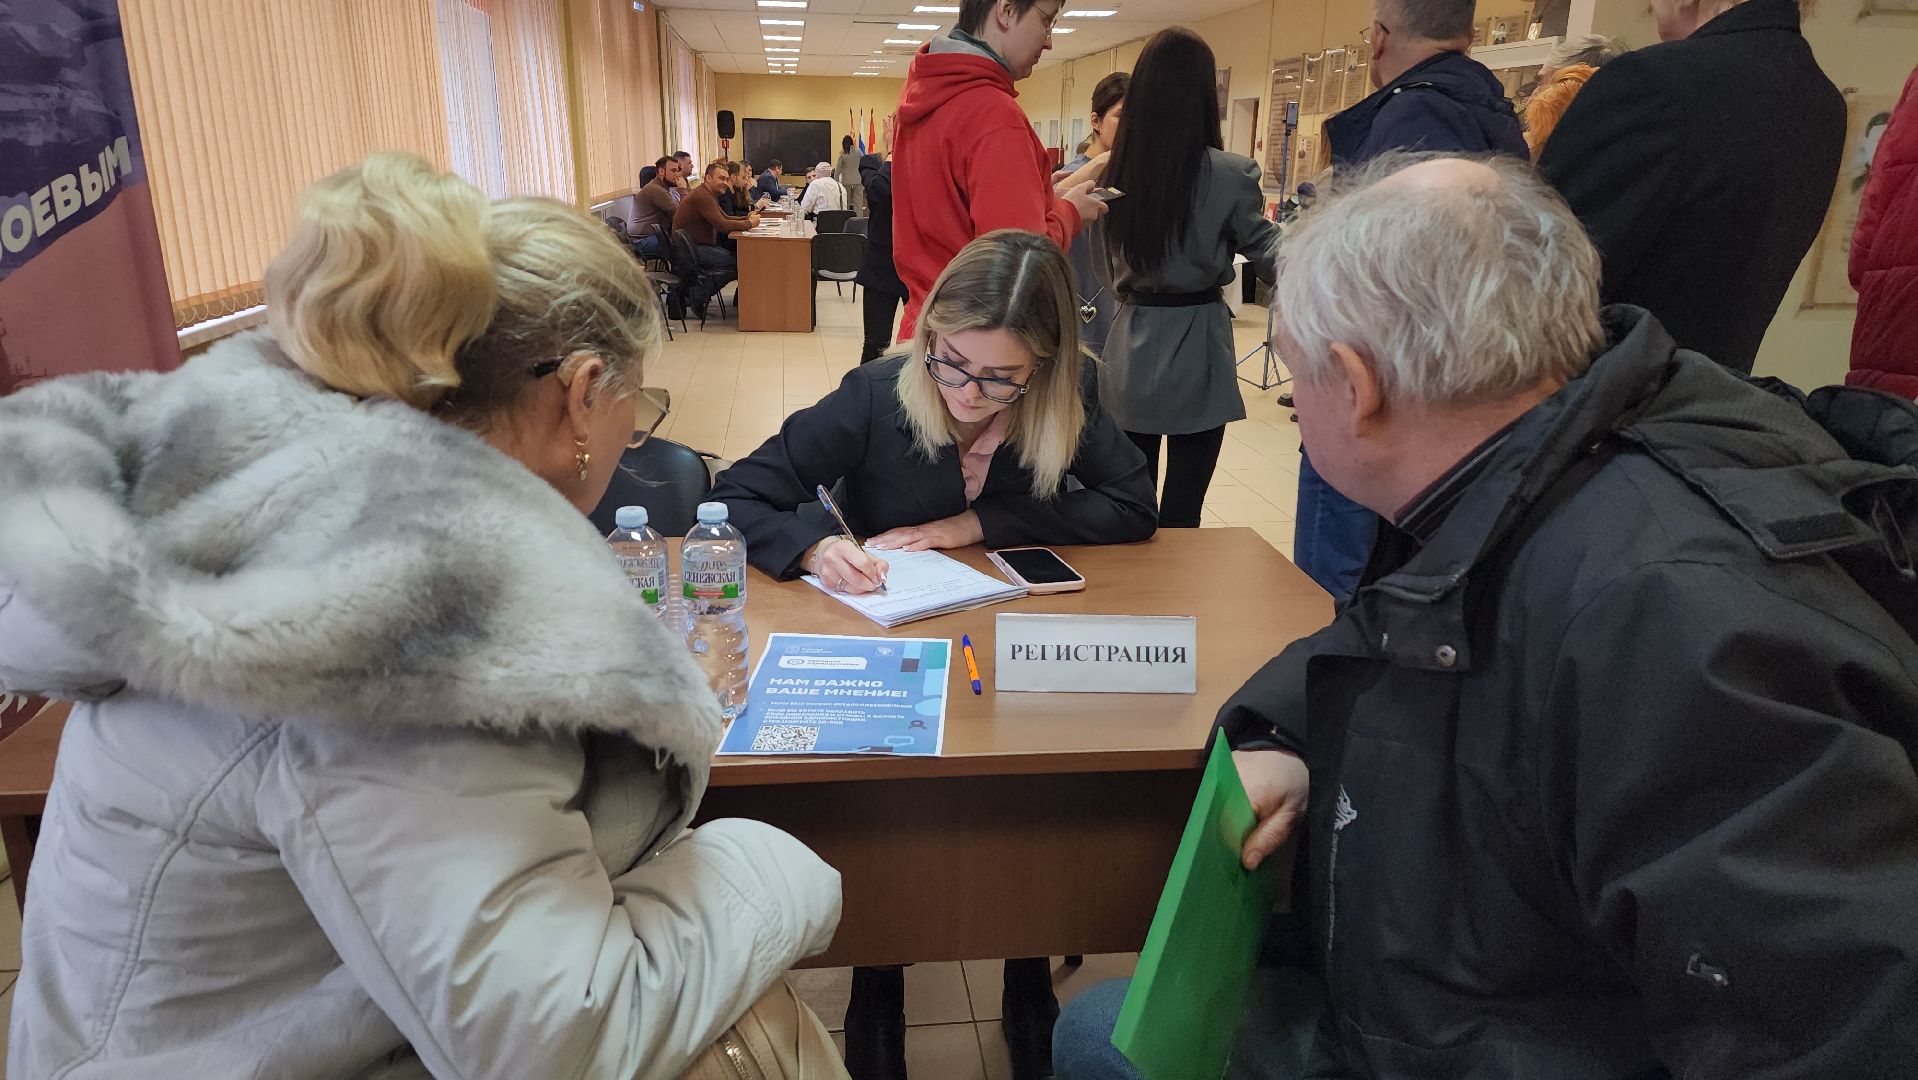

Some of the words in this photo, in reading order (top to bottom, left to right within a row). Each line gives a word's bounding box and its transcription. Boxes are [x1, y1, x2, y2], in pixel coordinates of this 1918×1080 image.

[0, 135, 132, 261] ОЕВЫМ
[1009, 643, 1187, 667] РЕГИСТРАЦИЯ
[769, 678, 810, 686] НАМ
[813, 679, 884, 688] ВАЖНО
[766, 687, 820, 696] ВАШЕ
[823, 688, 908, 698] МНЕНИЕ!
